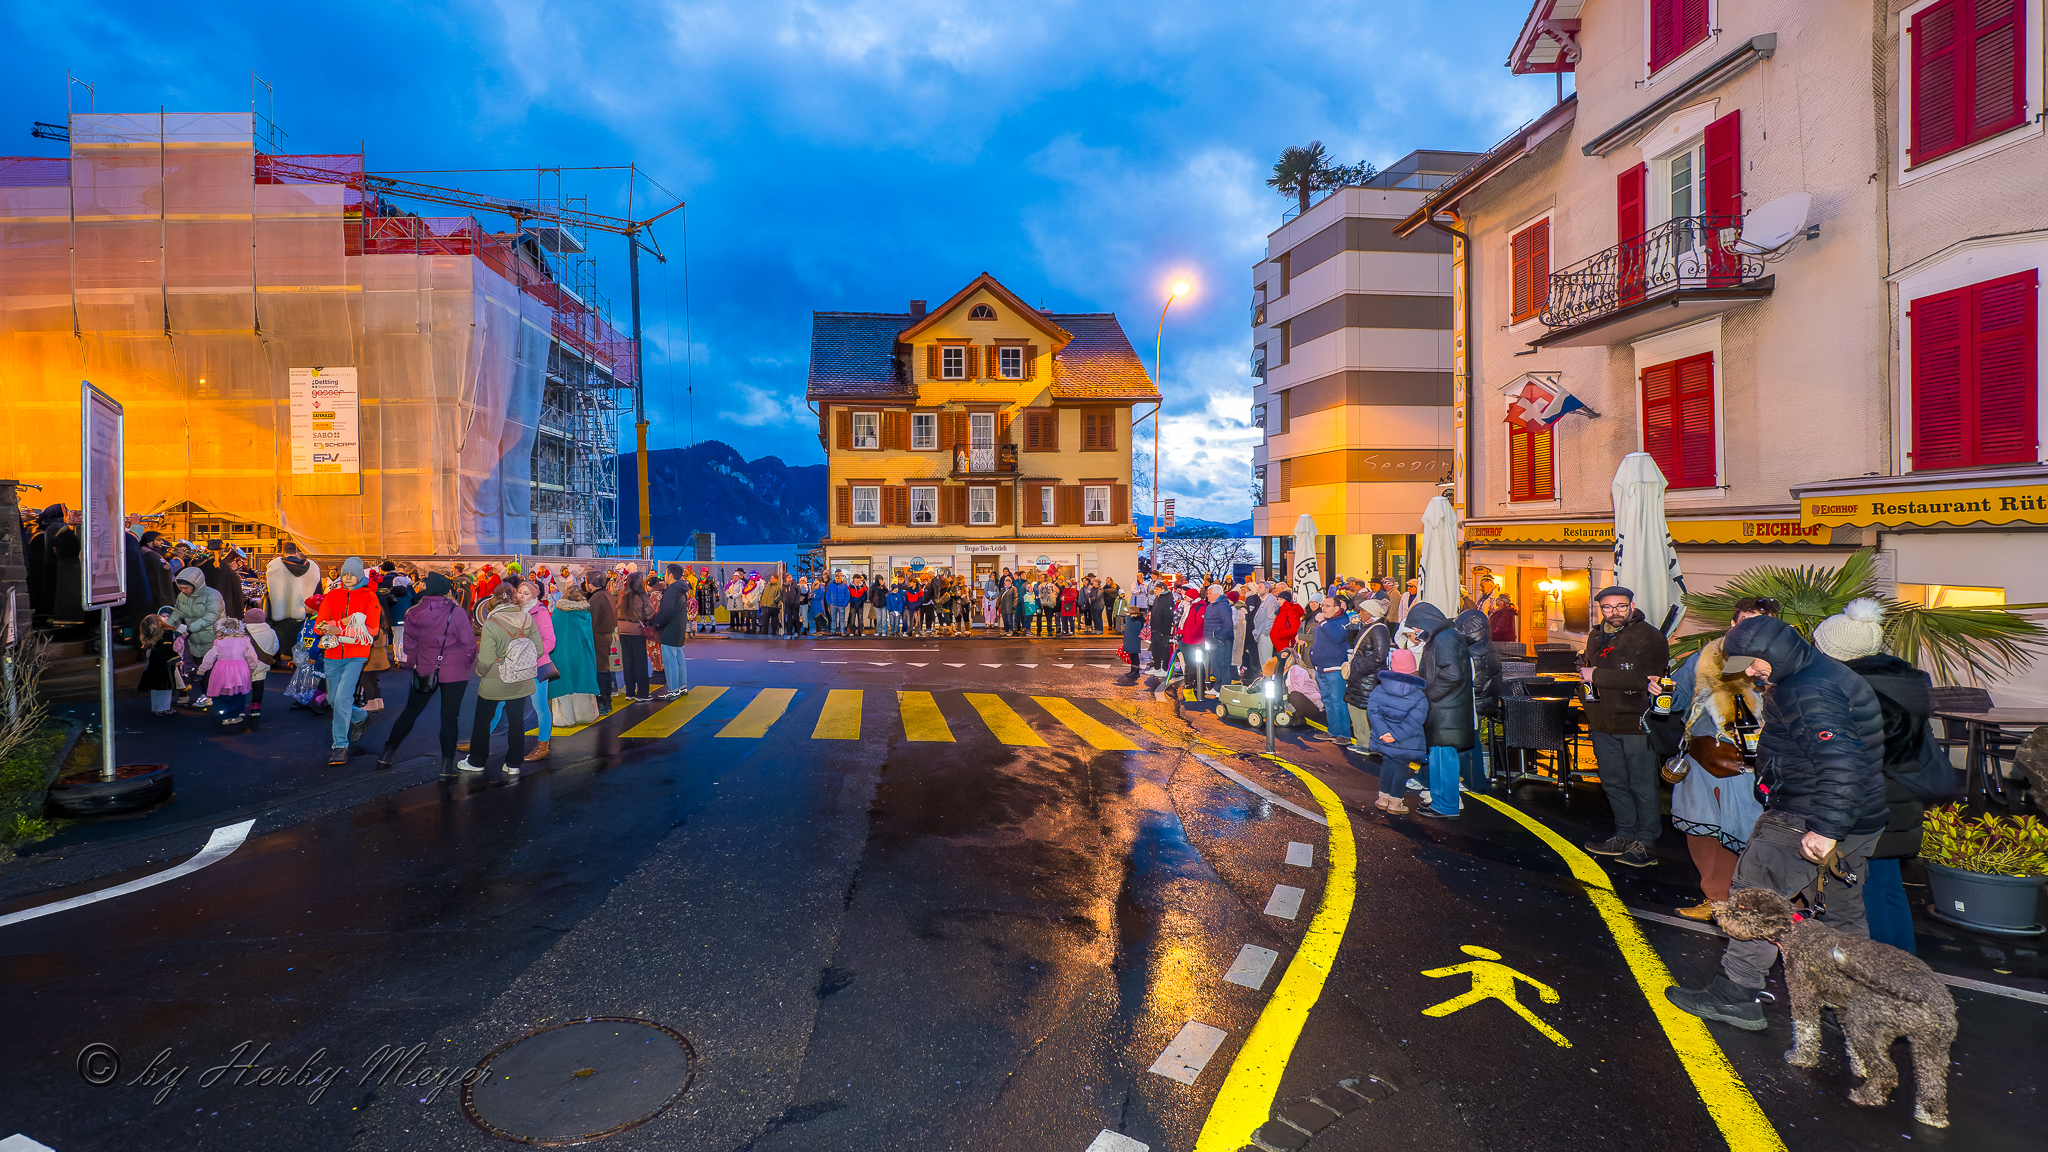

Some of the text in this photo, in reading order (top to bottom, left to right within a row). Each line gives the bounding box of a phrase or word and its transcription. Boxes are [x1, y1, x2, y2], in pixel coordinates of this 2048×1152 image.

[313, 453, 340, 462] EPV
[1820, 504, 1859, 515] EICHHOF
[1871, 494, 2048, 516] Restaurant Rüt
[1563, 527, 1615, 537] Restaurant
[1756, 522, 1822, 537] EICHHOF
